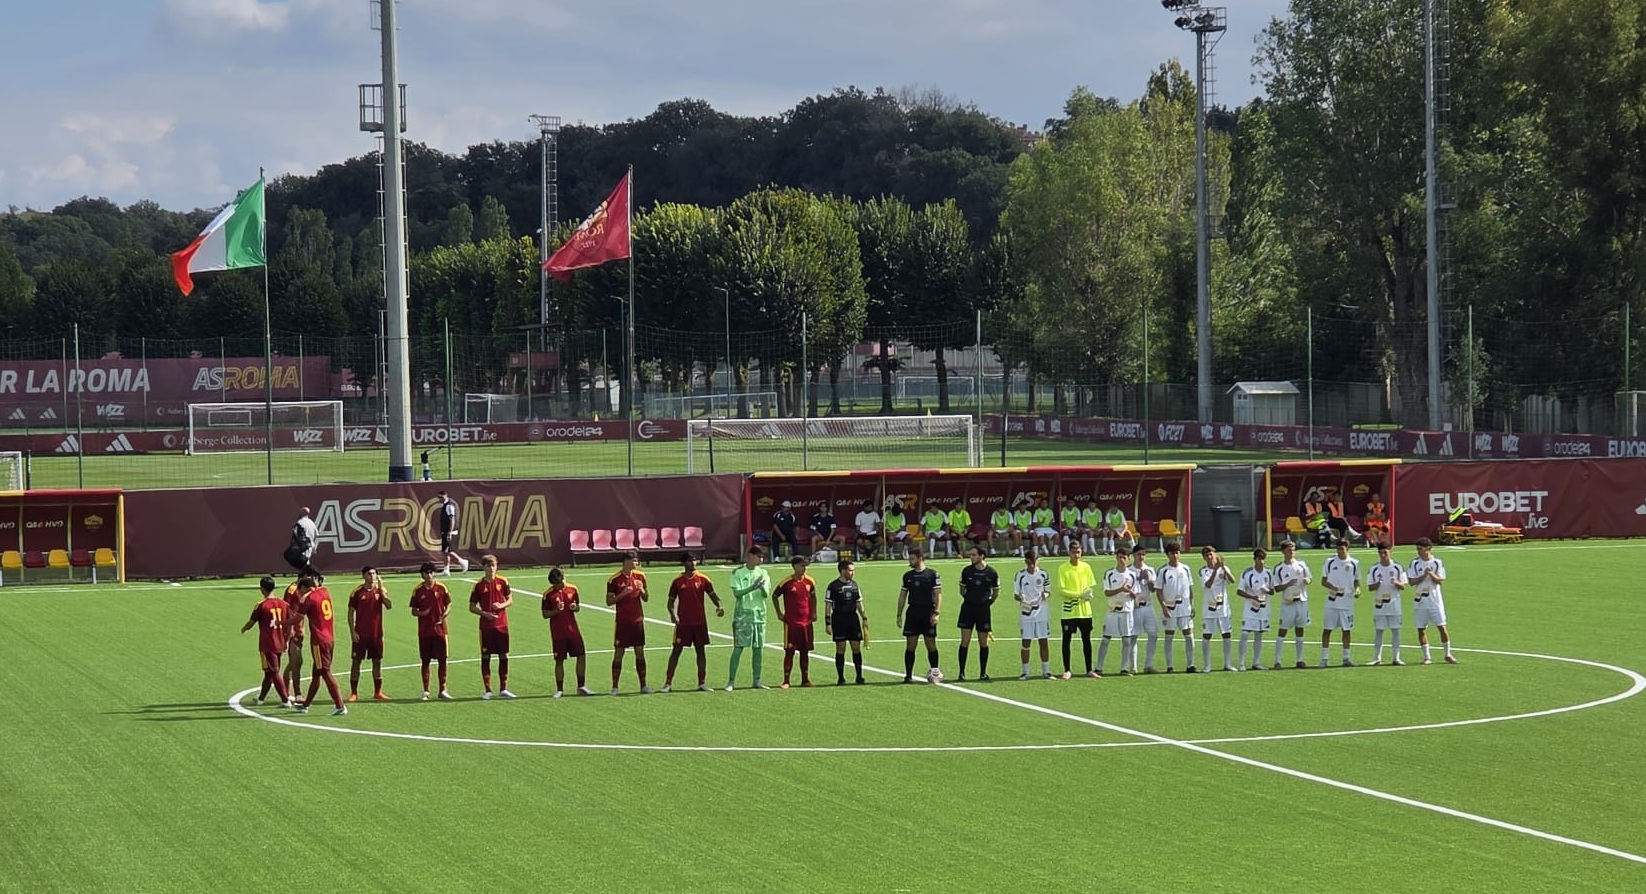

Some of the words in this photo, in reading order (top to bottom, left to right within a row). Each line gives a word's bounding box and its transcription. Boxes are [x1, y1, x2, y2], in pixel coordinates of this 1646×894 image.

[26, 369, 60, 393] LA
[68, 368, 151, 393] ROMA
[180, 436, 219, 447] Aberge
[220, 435, 267, 445] Collection
[1429, 491, 1548, 514] EUROBET
[270, 607, 282, 622] 11
[321, 599, 333, 621] 9
